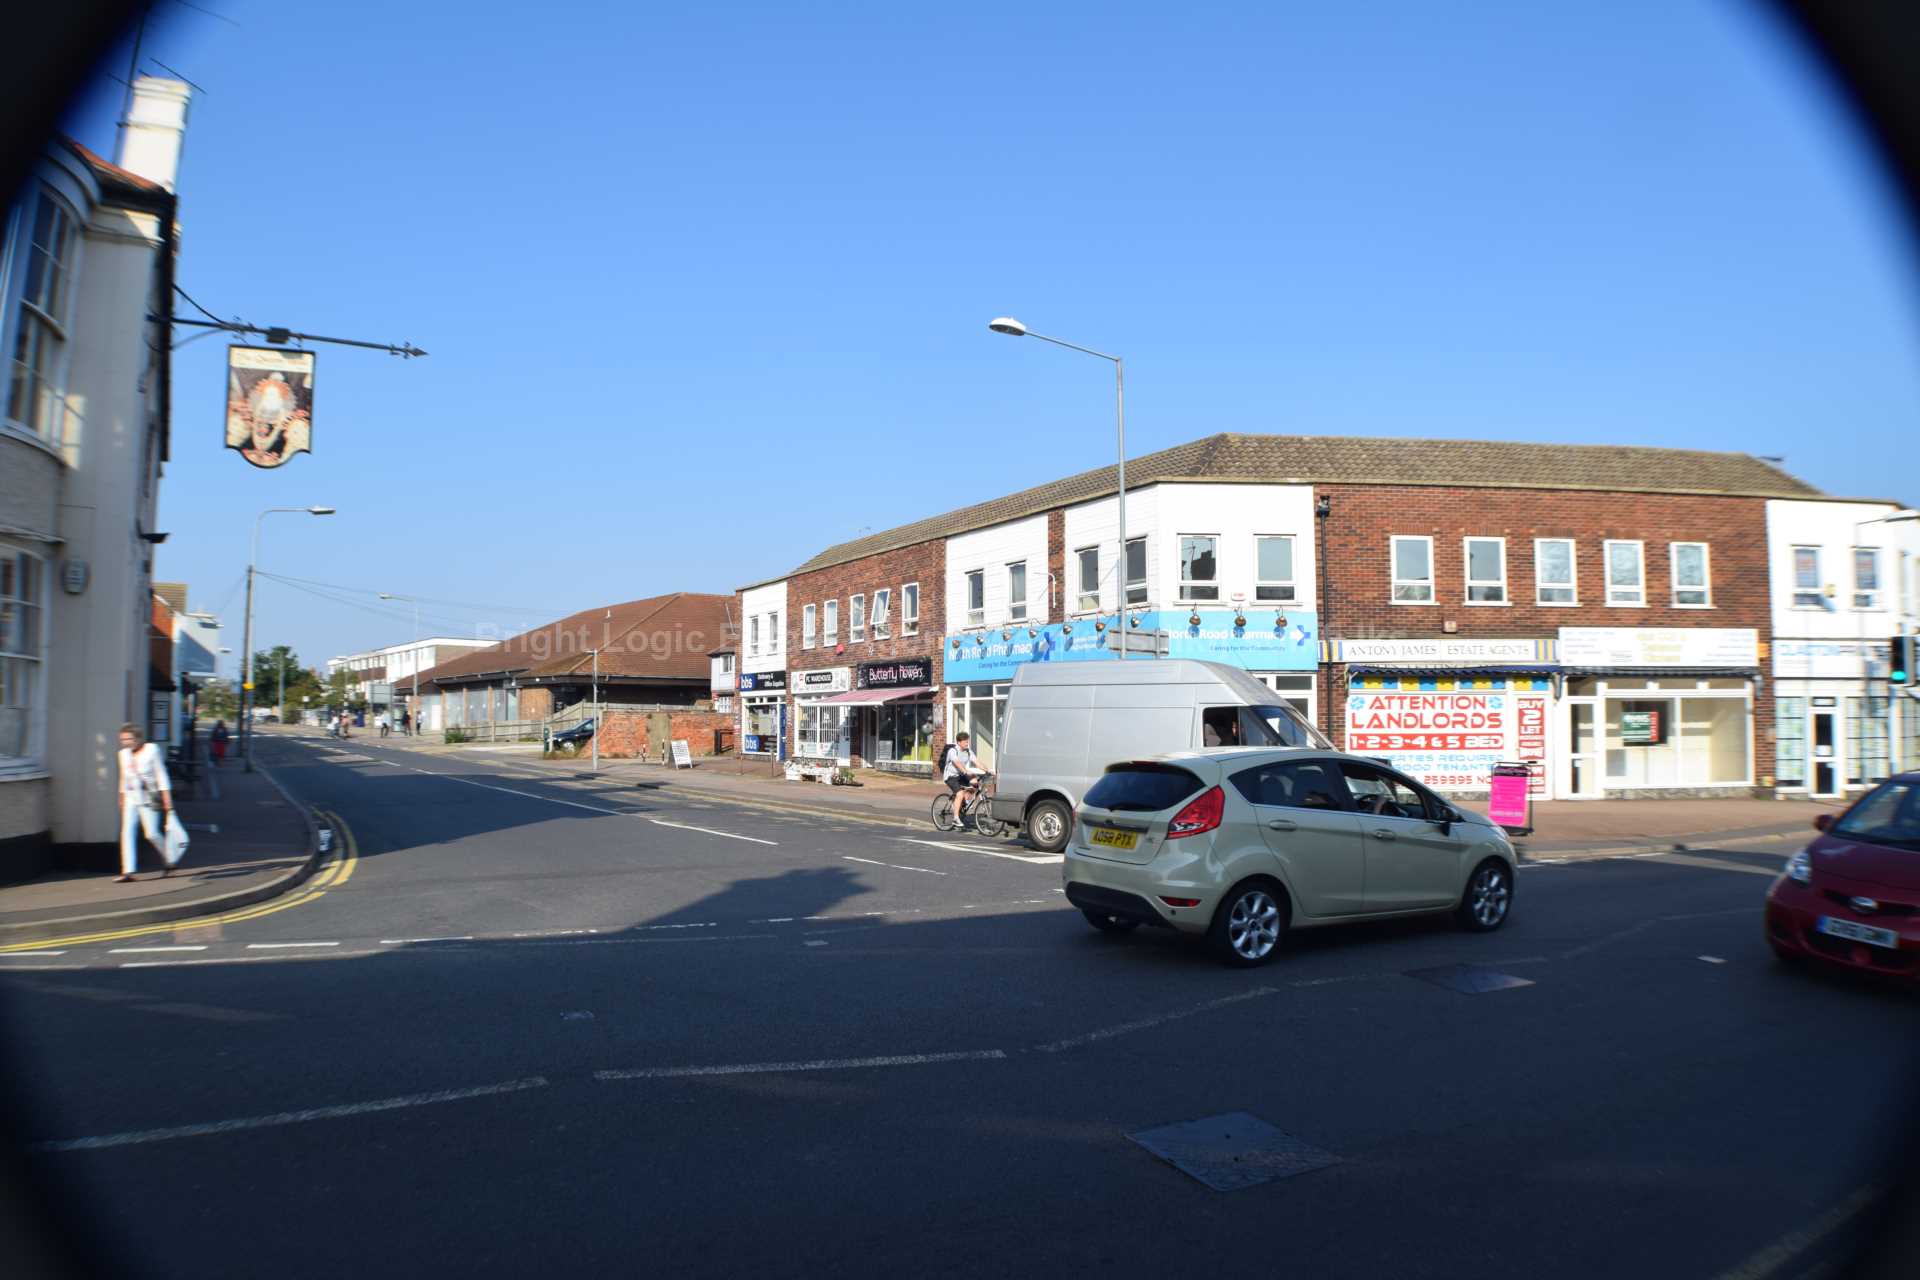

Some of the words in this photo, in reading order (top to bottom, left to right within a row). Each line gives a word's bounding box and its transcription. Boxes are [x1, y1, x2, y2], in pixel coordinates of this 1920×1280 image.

[1200, 629, 1228, 641] Road
[1350, 646, 1399, 656] ANTONY
[1401, 645, 1437, 655] JAMES
[1447, 645, 1484, 655] ESTATE
[1488, 645, 1530, 655] AGENTS
[869, 667, 898, 681] Butterfly
[741, 675, 753, 689] bbs
[1369, 696, 1486, 710] ATTENTION
[1352, 712, 1502, 729] LANDLORDS
[745, 737, 757, 750] bbs
[1350, 735, 1427, 749] 1-2-3-4
[1446, 736, 1461, 749] 5
[1464, 735, 1503, 749] BED
[1438, 754, 1504, 763] REQUIRED
